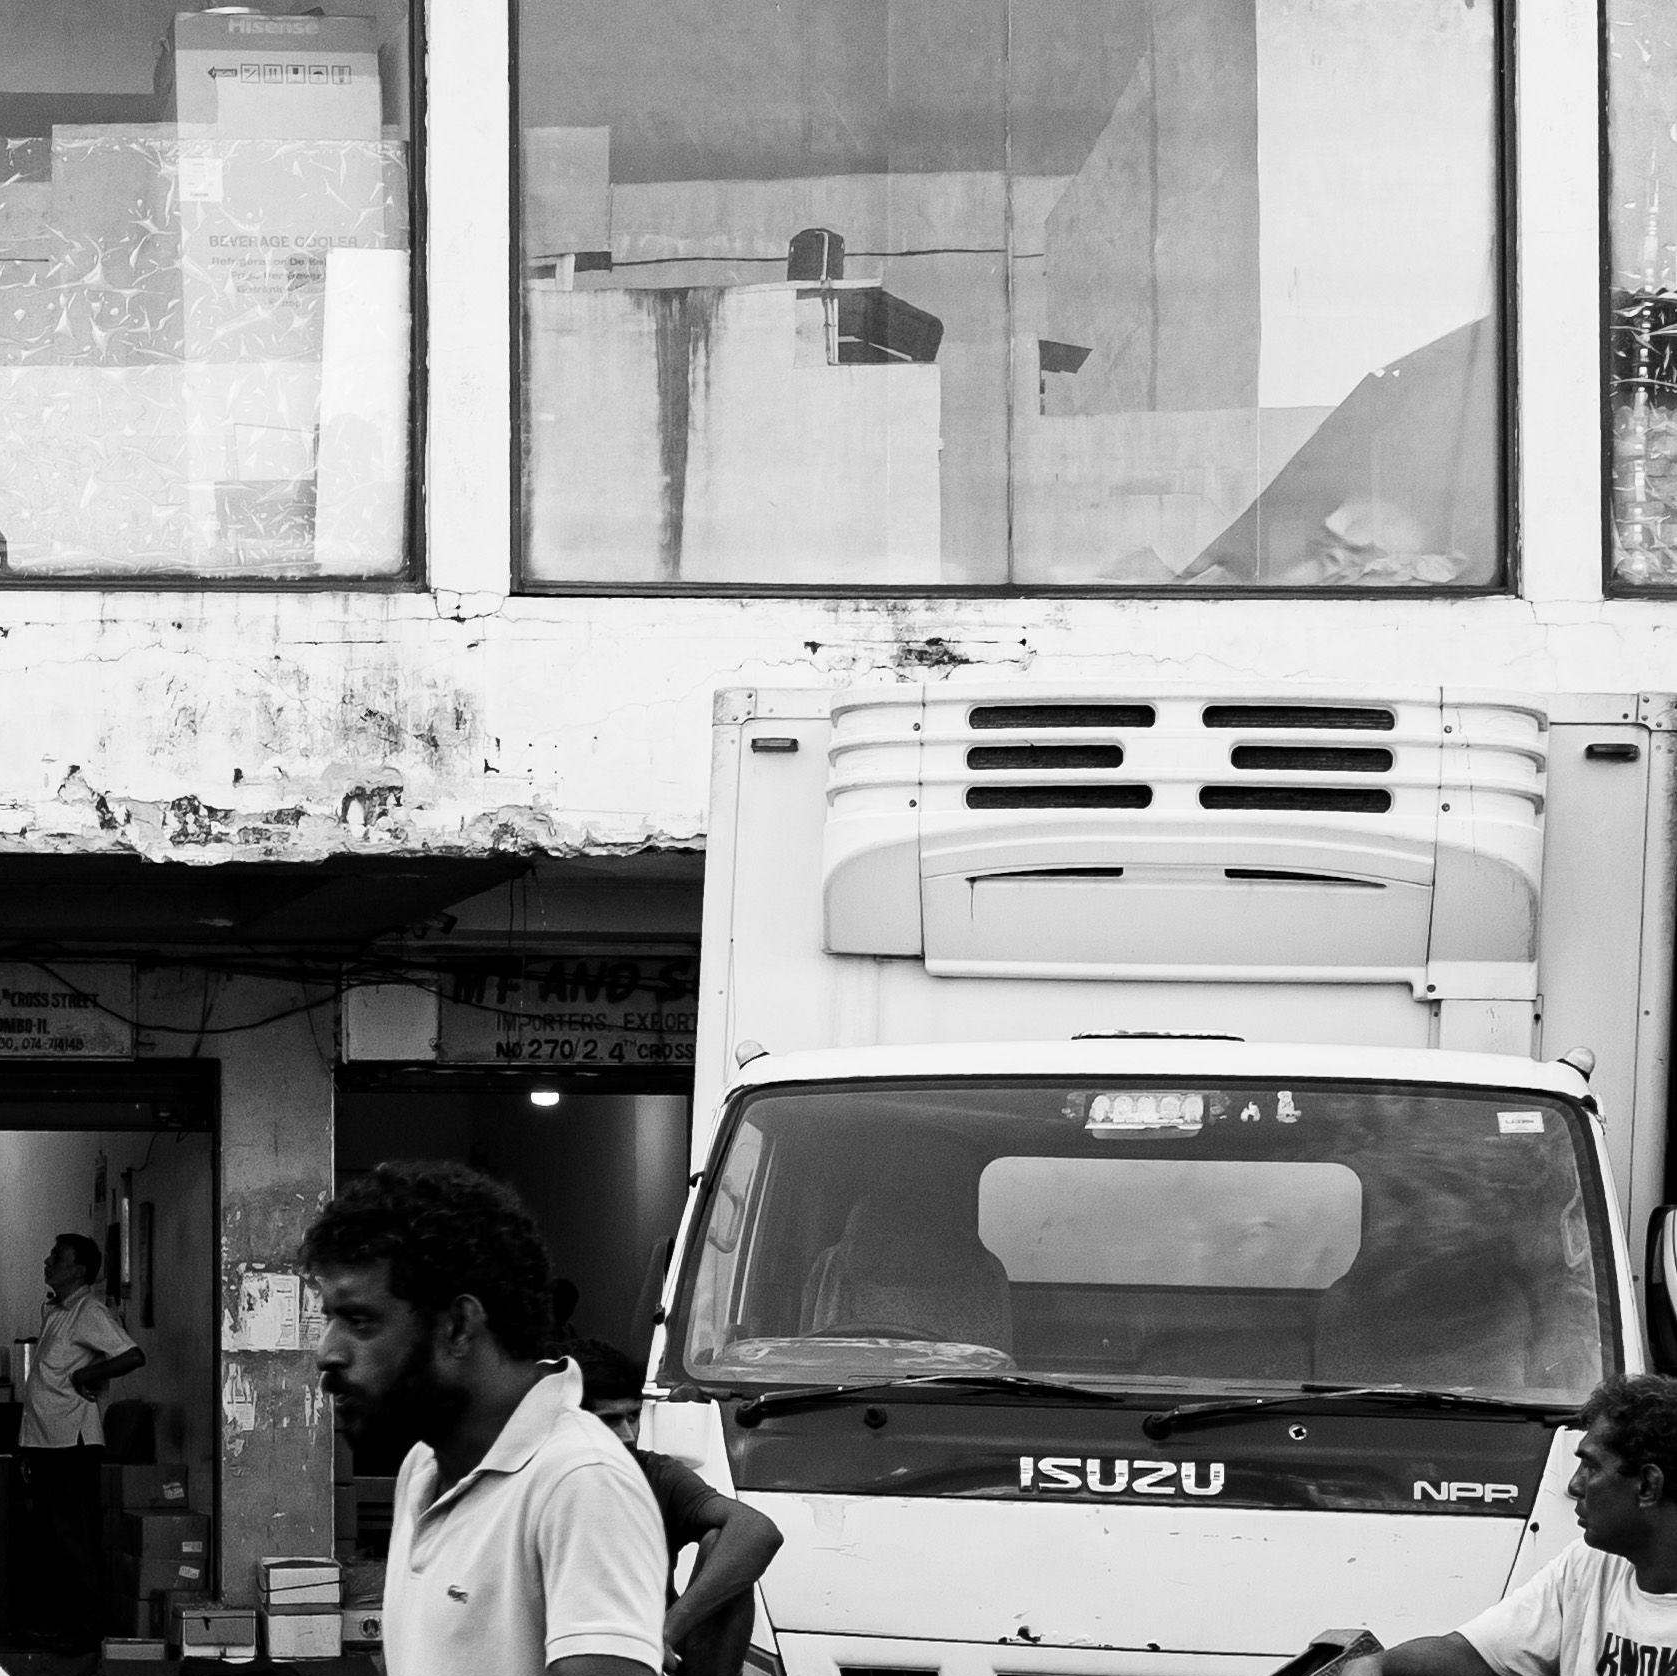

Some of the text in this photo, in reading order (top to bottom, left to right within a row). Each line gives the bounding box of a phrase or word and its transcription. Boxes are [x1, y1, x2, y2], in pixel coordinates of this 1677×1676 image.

[227, 19, 320, 35] Hisense
[209, 235, 290, 248] BEVERAGE
[11, 991, 50, 1008] CROSS
[1019, 1455, 1225, 1497] ISUZU
